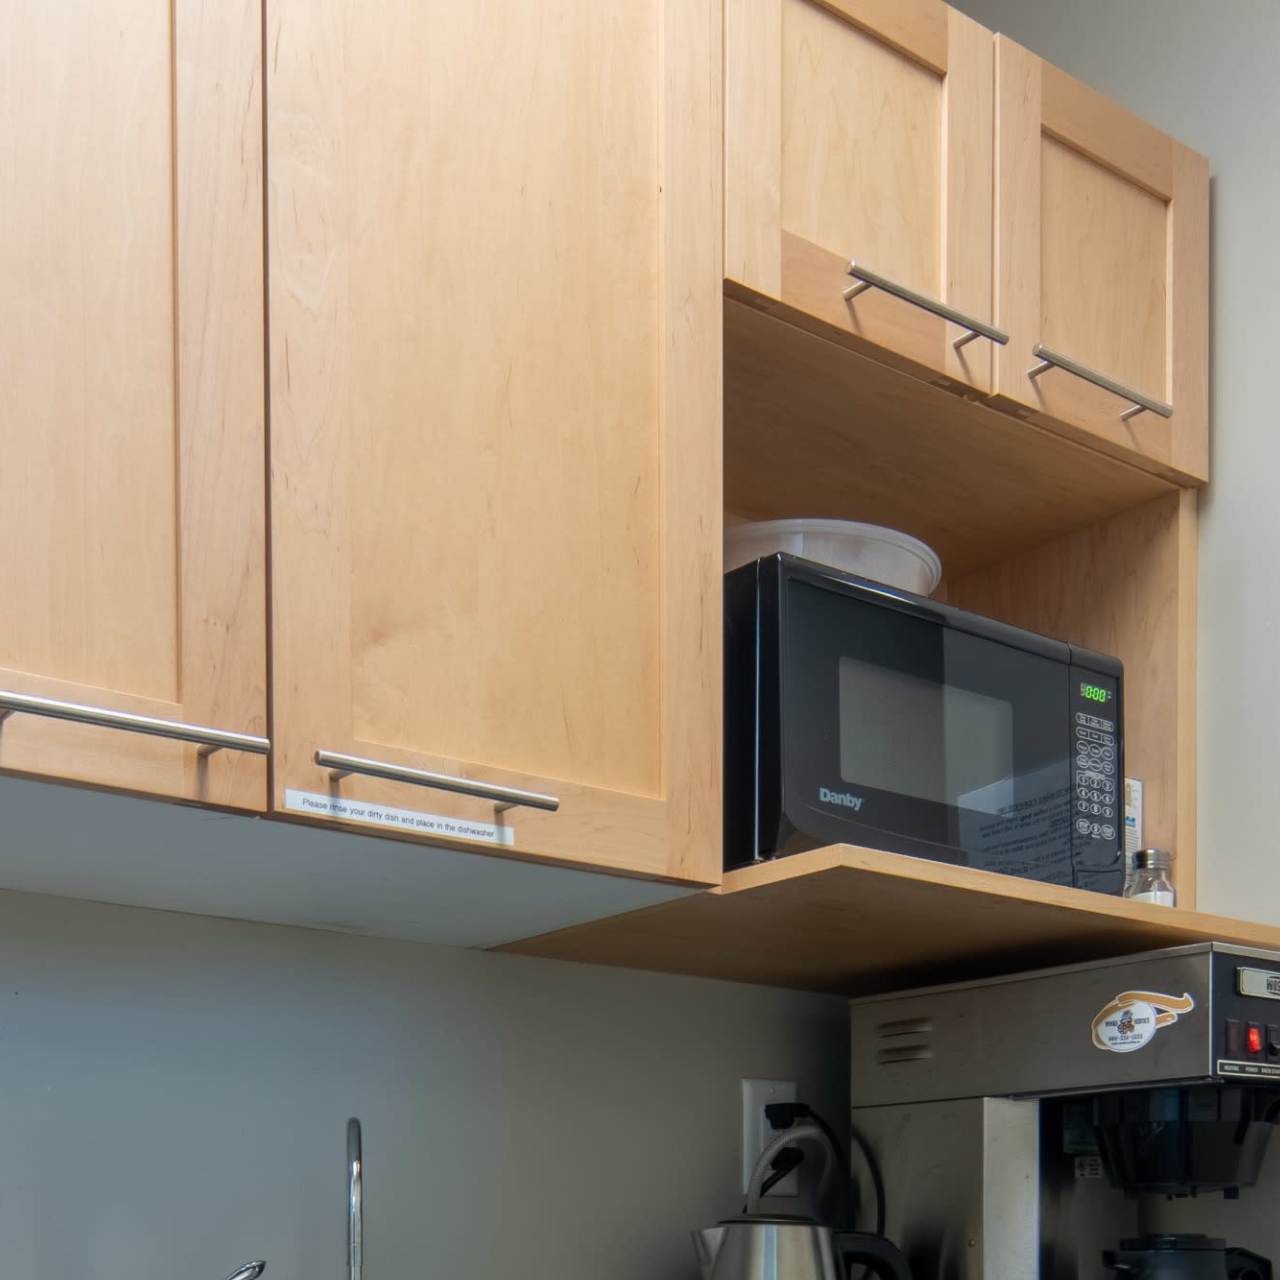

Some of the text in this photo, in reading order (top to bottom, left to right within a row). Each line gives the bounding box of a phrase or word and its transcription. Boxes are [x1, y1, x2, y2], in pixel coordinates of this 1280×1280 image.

[302, 797, 328, 810] Please
[350, 807, 365, 817] your
[367, 809, 382, 819] dirty
[401, 816, 414, 825] and
[416, 818, 434, 829] place
[444, 823, 456, 832] the
[819, 787, 863, 812] Danby
